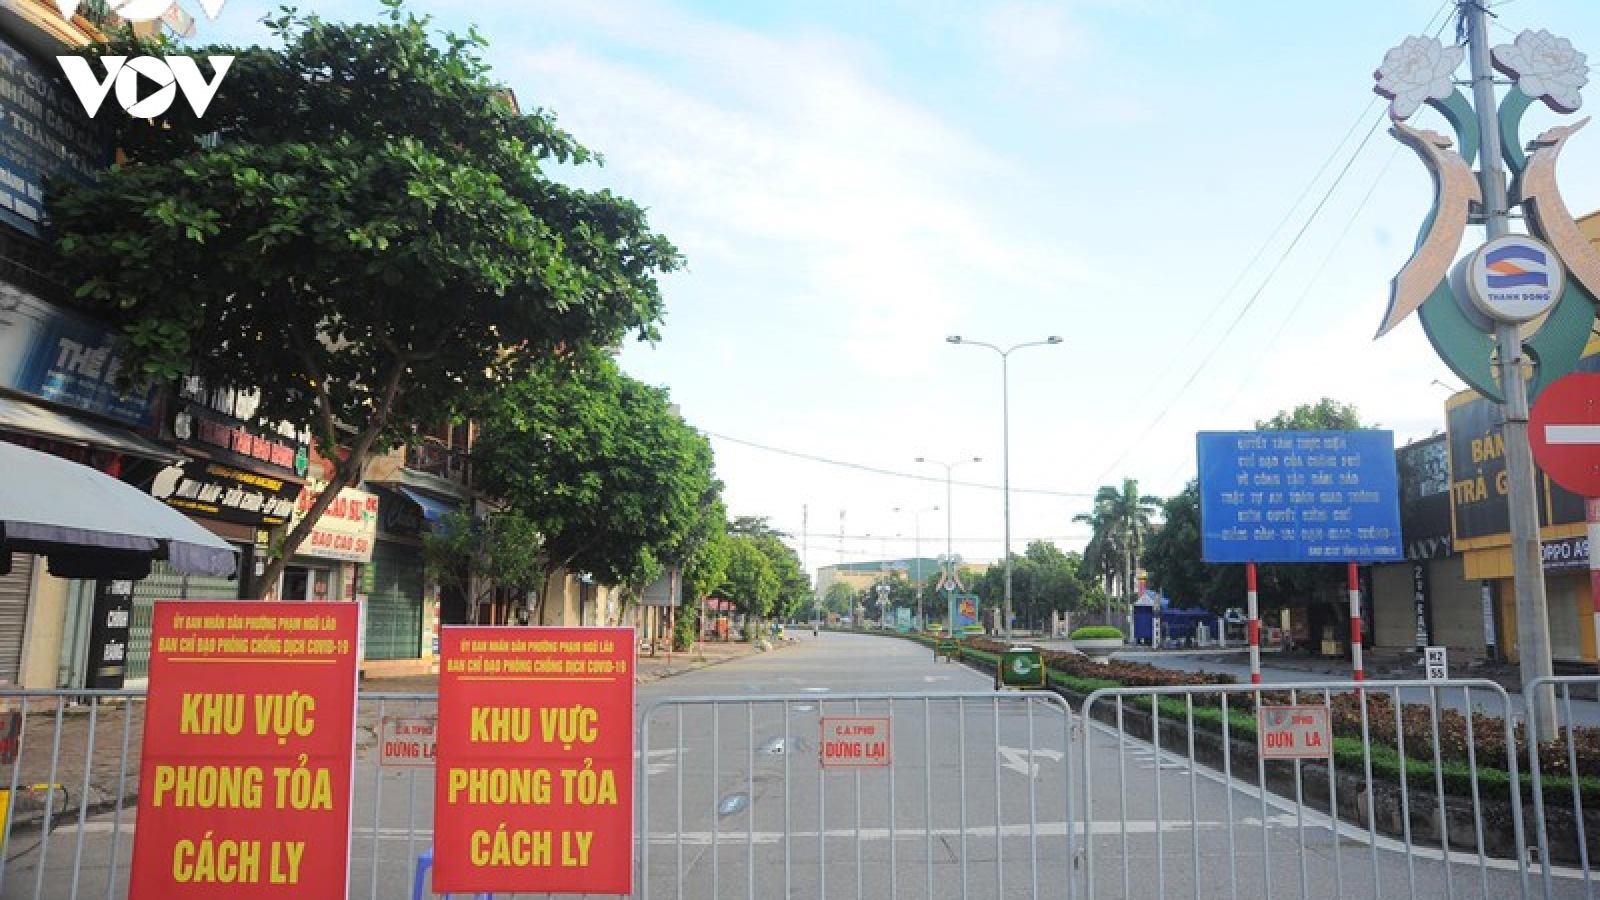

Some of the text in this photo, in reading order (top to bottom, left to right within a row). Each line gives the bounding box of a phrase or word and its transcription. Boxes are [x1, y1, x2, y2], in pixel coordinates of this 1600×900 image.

[180, 690, 315, 745] KHU VỰC
[471, 704, 598, 750] KHU VỰC
[153, 753, 333, 810] PHONG TỎA
[448, 758, 618, 804] PHONG TỎA
[173, 830, 305, 884] CÁCH LY
[471, 822, 593, 867] CÁCH LY
